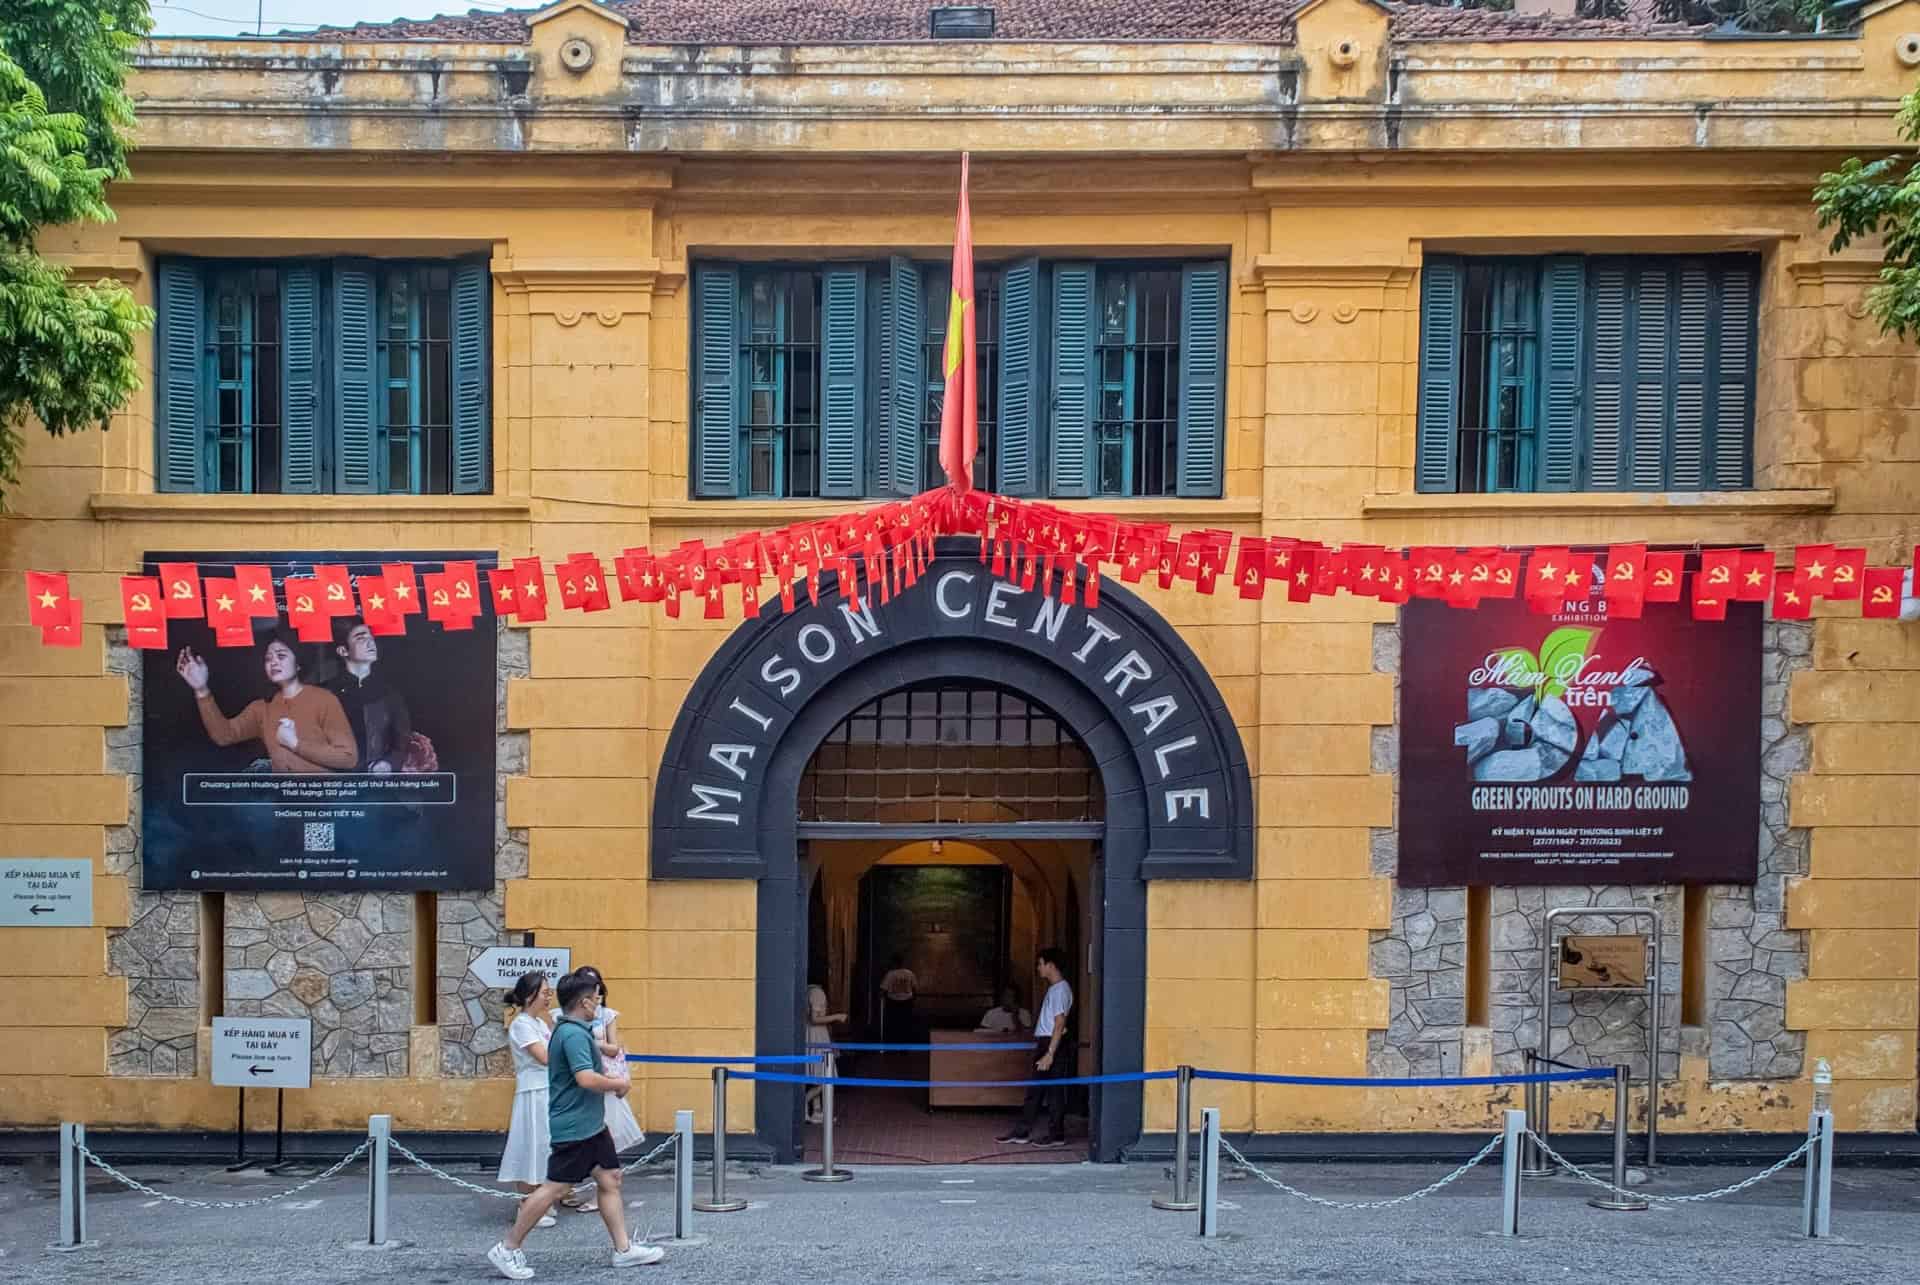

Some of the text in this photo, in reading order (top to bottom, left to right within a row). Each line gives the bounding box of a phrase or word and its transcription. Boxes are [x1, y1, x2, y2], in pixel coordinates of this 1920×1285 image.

[1551, 614, 1608, 622] EXHIBITION
[1554, 653, 1645, 686] Xanh
[687, 569, 1210, 826] MAISON CENTRALE
[1564, 687, 1612, 706] trên
[1472, 786, 1689, 810] GREEN SPROUTS ON HARD GROUND
[520, 955, 542, 967] BÁN
[497, 968, 527, 977] Ticket
